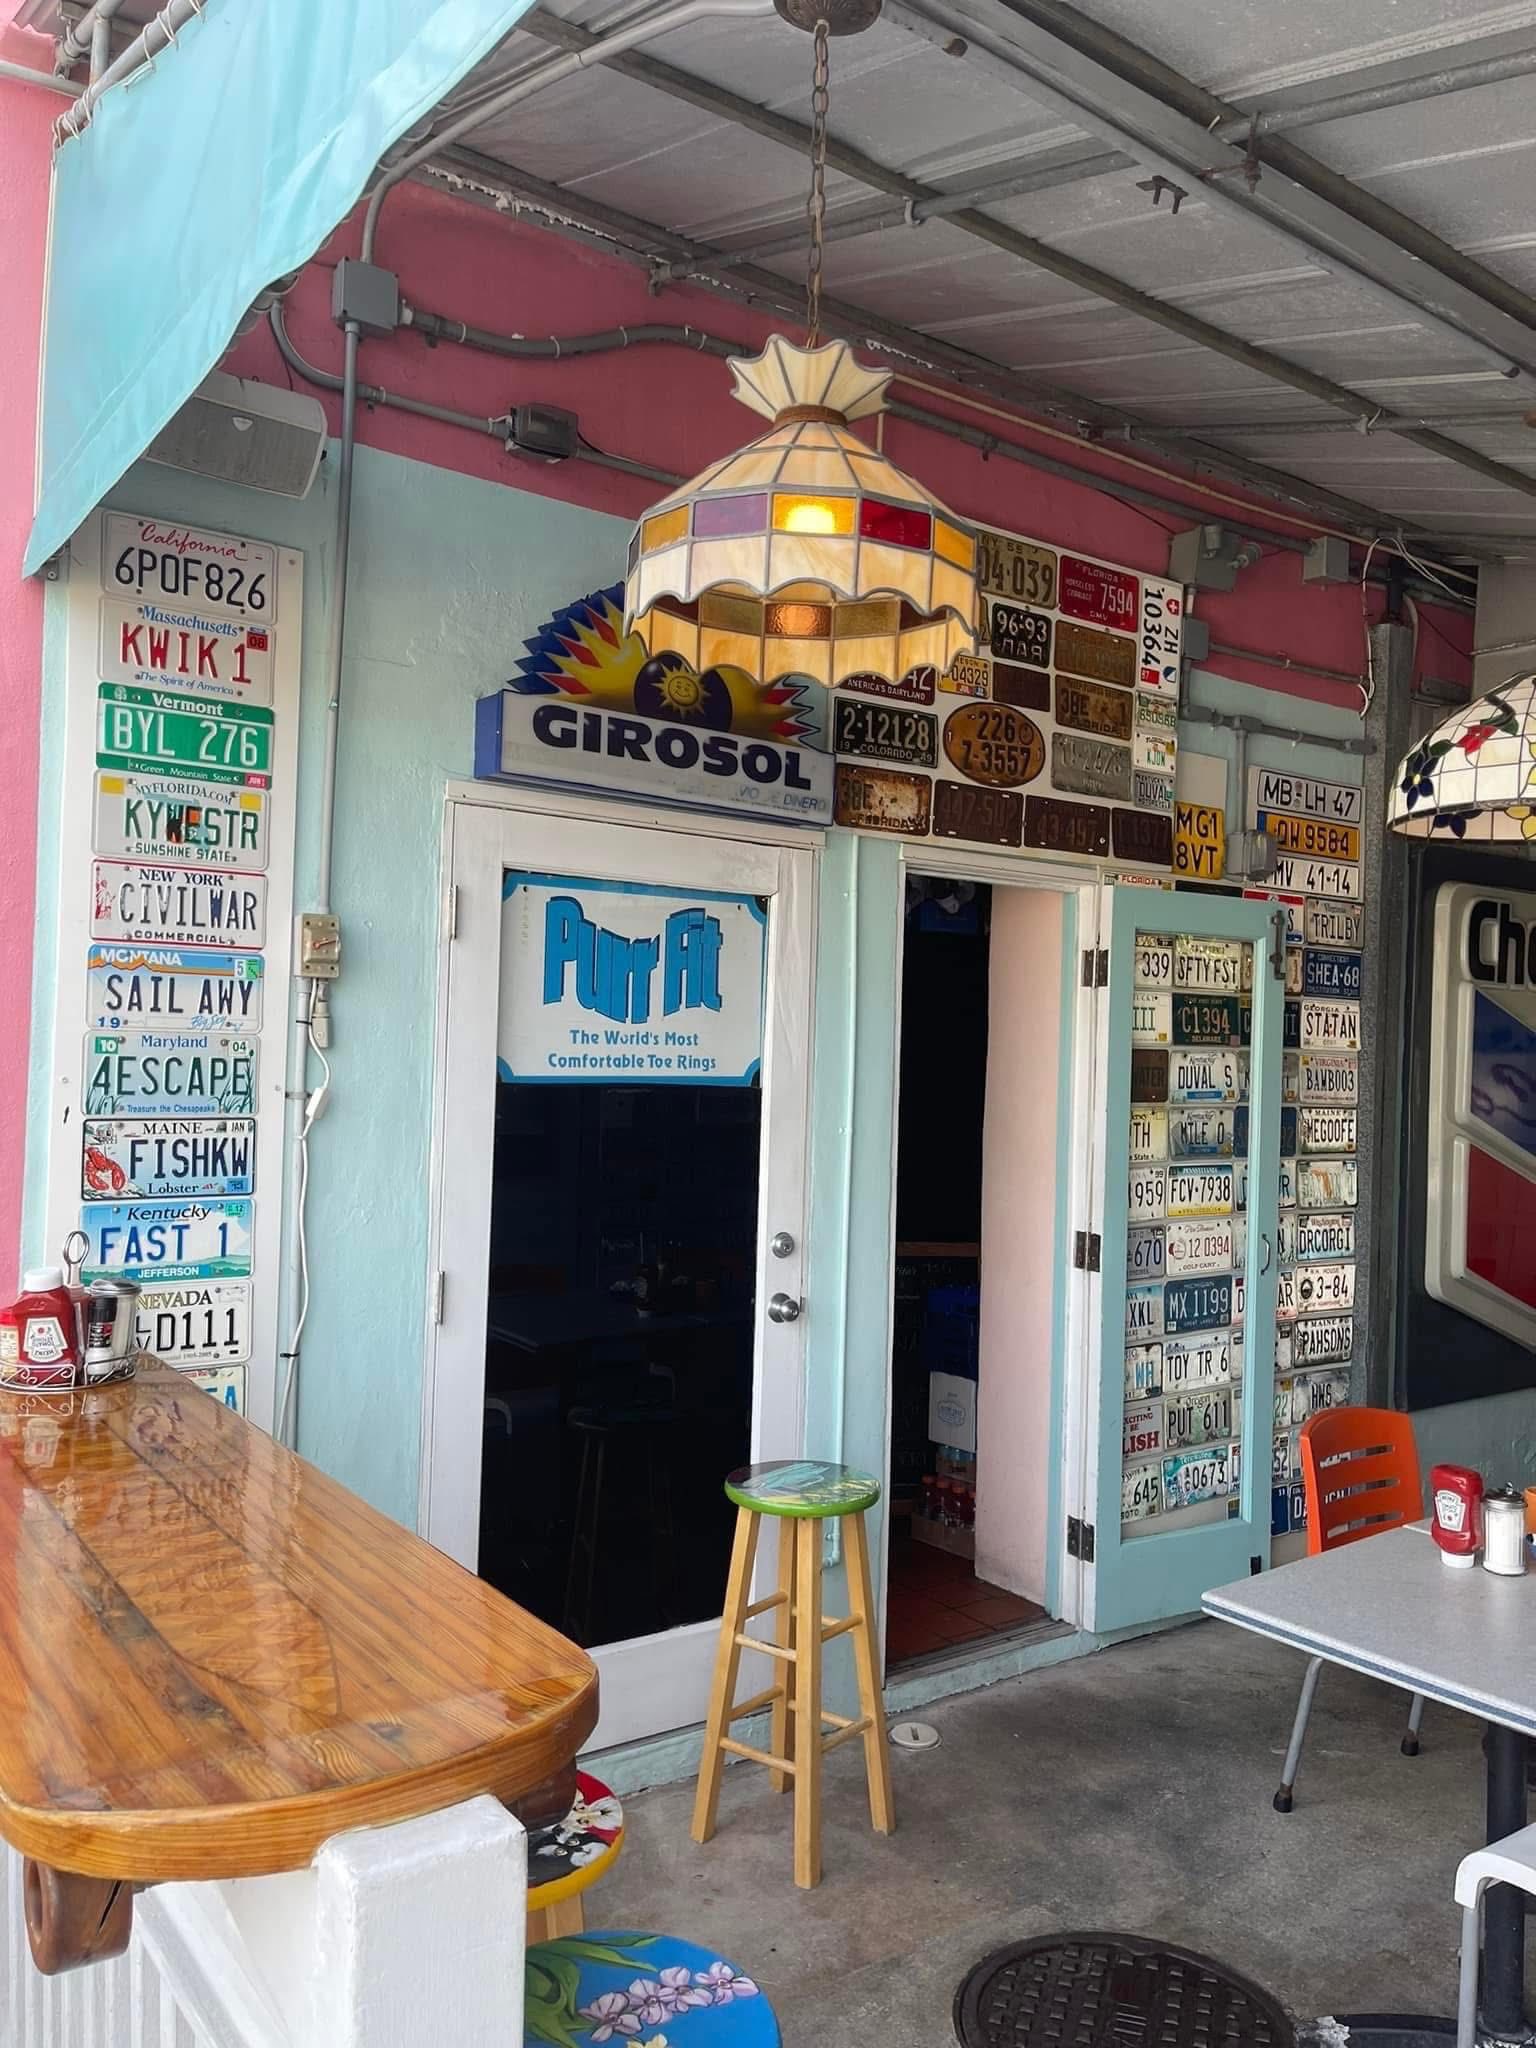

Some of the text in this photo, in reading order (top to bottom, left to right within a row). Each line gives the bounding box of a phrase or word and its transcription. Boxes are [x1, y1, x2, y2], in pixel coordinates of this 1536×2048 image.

[140, 523, 248, 561] California
[1081, 566, 1120, 584] FLORIDA
[1099, 583, 1134, 617] 7594
[141, 604, 240, 637] Massachusetts
[1141, 587, 1165, 667] 10364
[119, 621, 253, 685] KWIK 1
[1164, 625, 1179, 655] ZH
[138, 671, 235, 696] The Spirit of America
[847, 679, 926, 701] AMERICA'S DAIRYLAND
[151, 691, 224, 717] Vermont
[113, 707, 259, 768] BYL 276
[977, 711, 1016, 743] 226
[532, 703, 812, 791] GIROSOL
[859, 743, 913, 762] COLORADO
[139, 763, 232, 783] Green Mountain State
[1333, 790, 1355, 817] 47
[1176, 807, 1218, 839] MG1
[135, 842, 232, 863] SUNSHINE STATE
[1304, 824, 1349, 857] 9584
[1176, 841, 1218, 874] 8VT
[138, 868, 224, 887] NEW YORK
[1120, 875, 1160, 887] FLORIDA
[119, 882, 258, 931] CIVILWAR
[134, 930, 227, 945] COMMERCIAL
[543, 895, 661, 1025] Purr
[1141, 951, 1170, 979] 339
[106, 974, 254, 1016] SAIL AWY
[1303, 1003, 1340, 1013] GEORGIA
[141, 1035, 209, 1051] Maryland
[231, 1041, 247, 1053] 04
[570, 1029, 699, 1047] The World's Most
[92, 1055, 251, 1097] 4ESCAPE
[547, 1053, 717, 1072] Comfortable Toe Rings
[1178, 1066, 1216, 1089] DUVAL
[1224, 1065, 1233, 1088] S
[127, 1103, 216, 1114] Treasure the Chesapeake
[142, 1121, 203, 1136] MAINE
[231, 1122, 246, 1133] JAN
[129, 1137, 249, 1180] FISHKW
[147, 1182, 199, 1195] Lobster
[126, 1203, 212, 1221] Kentucky
[99, 1222, 228, 1265] FAST 1
[1188, 1235, 1229, 1258] 12 0394
[1299, 1227, 1351, 1255] DRCORGI
[137, 1266, 200, 1279] JEFFERSON
[136, 1289, 213, 1311] NEVADA
[1315, 1274, 1348, 1300] 3-84
[1169, 1291, 1188, 1320] MX
[1194, 1287, 1229, 1318] 1199
[1167, 1353, 1190, 1382] TOY
[1197, 1350, 1213, 1377] TR
[1220, 1346, 1228, 1372] 6
[1168, 1400, 1228, 1437] PUT 611
[1191, 1460, 1226, 1490] 0673
[1133, 1476, 1158, 1506] 645
